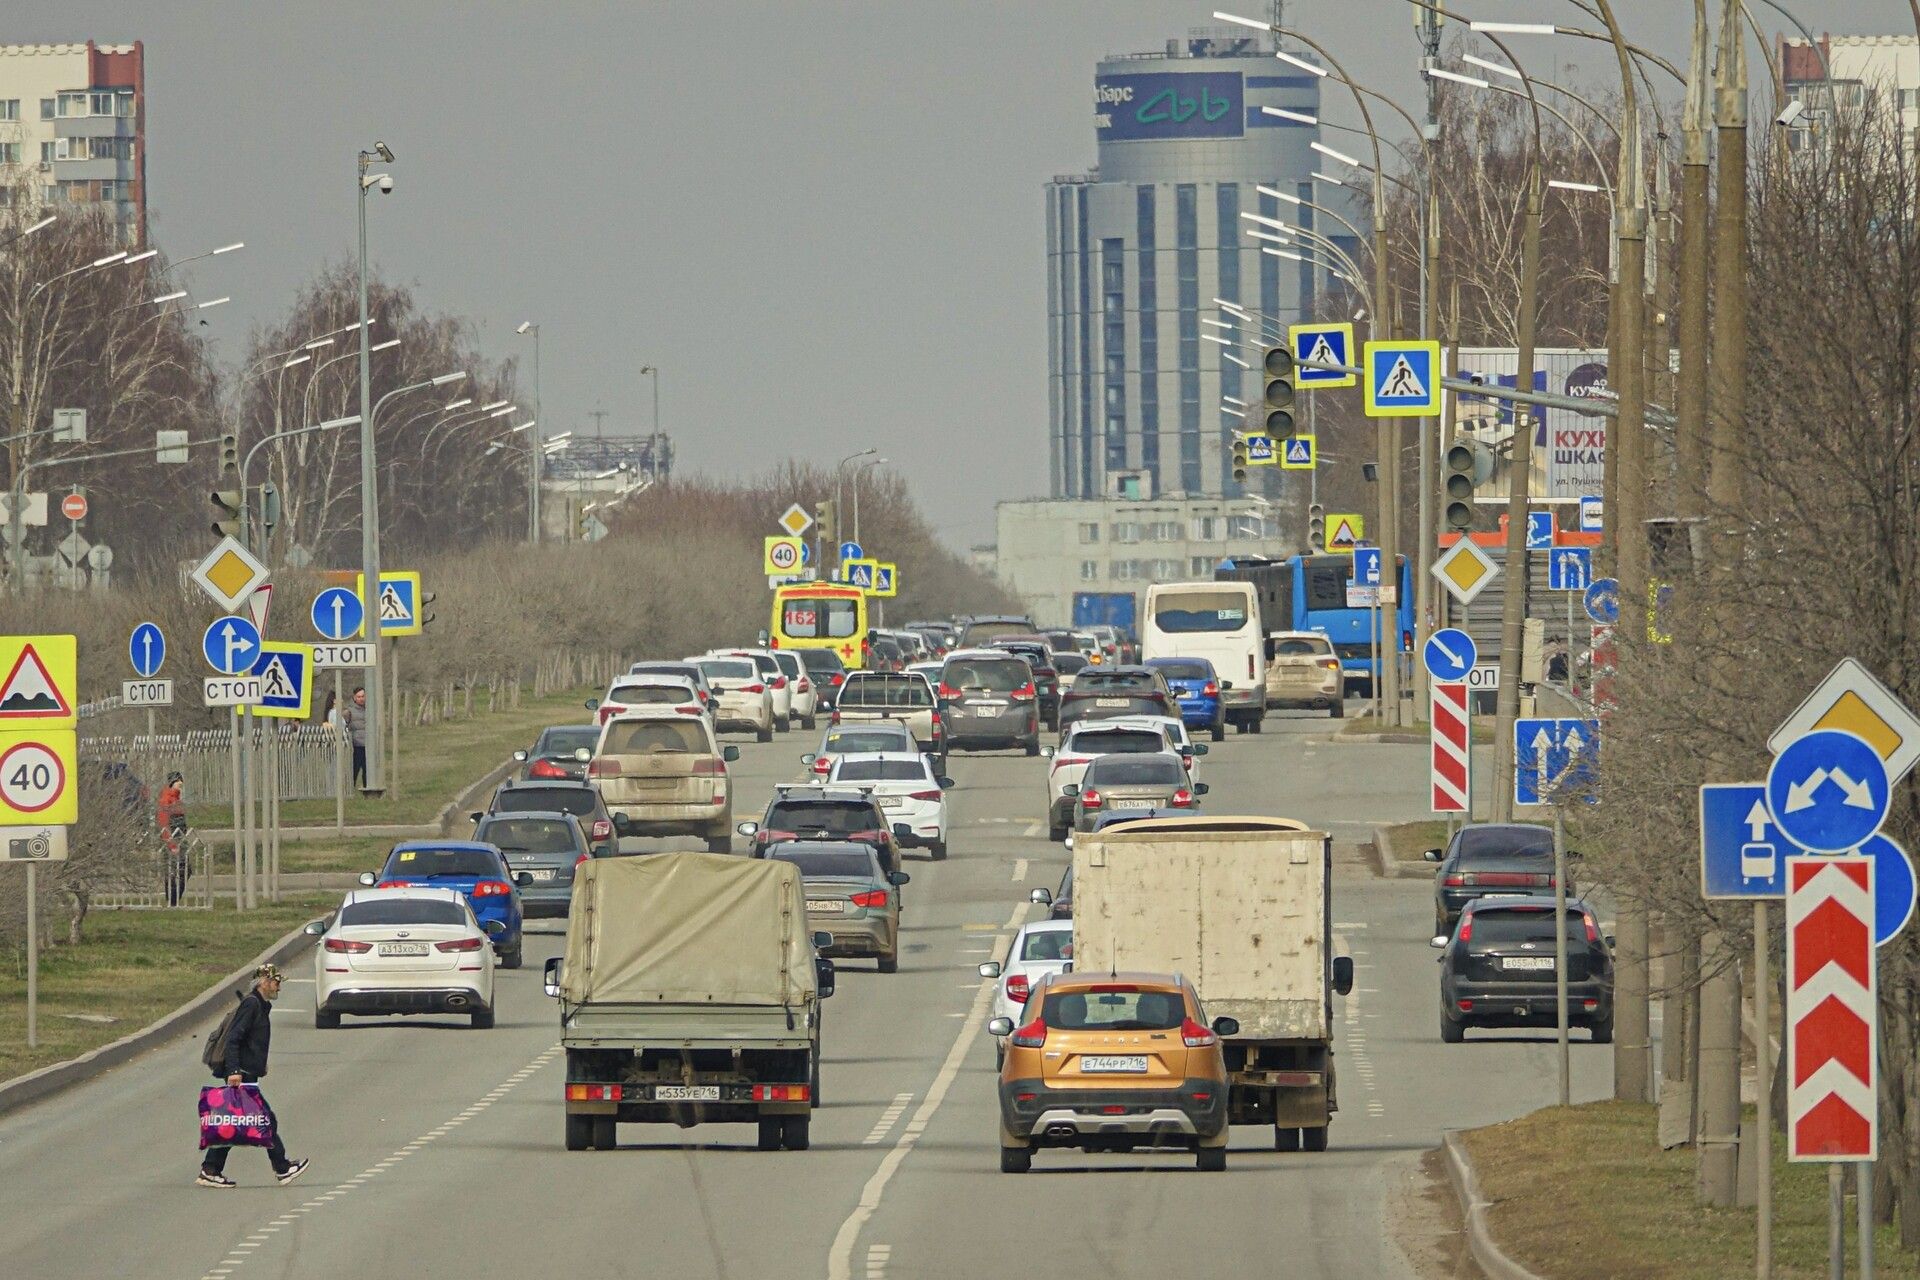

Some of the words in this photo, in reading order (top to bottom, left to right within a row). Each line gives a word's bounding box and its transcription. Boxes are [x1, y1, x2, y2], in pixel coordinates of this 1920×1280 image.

[775, 549, 792, 561] 40
[785, 609, 816, 625] 162
[312, 647, 367, 663] СТОП
[1469, 670, 1495, 686] ОП
[129, 683, 165, 701] СТОП
[206, 681, 260, 699] СТОП
[10, 763, 50, 791] 40
